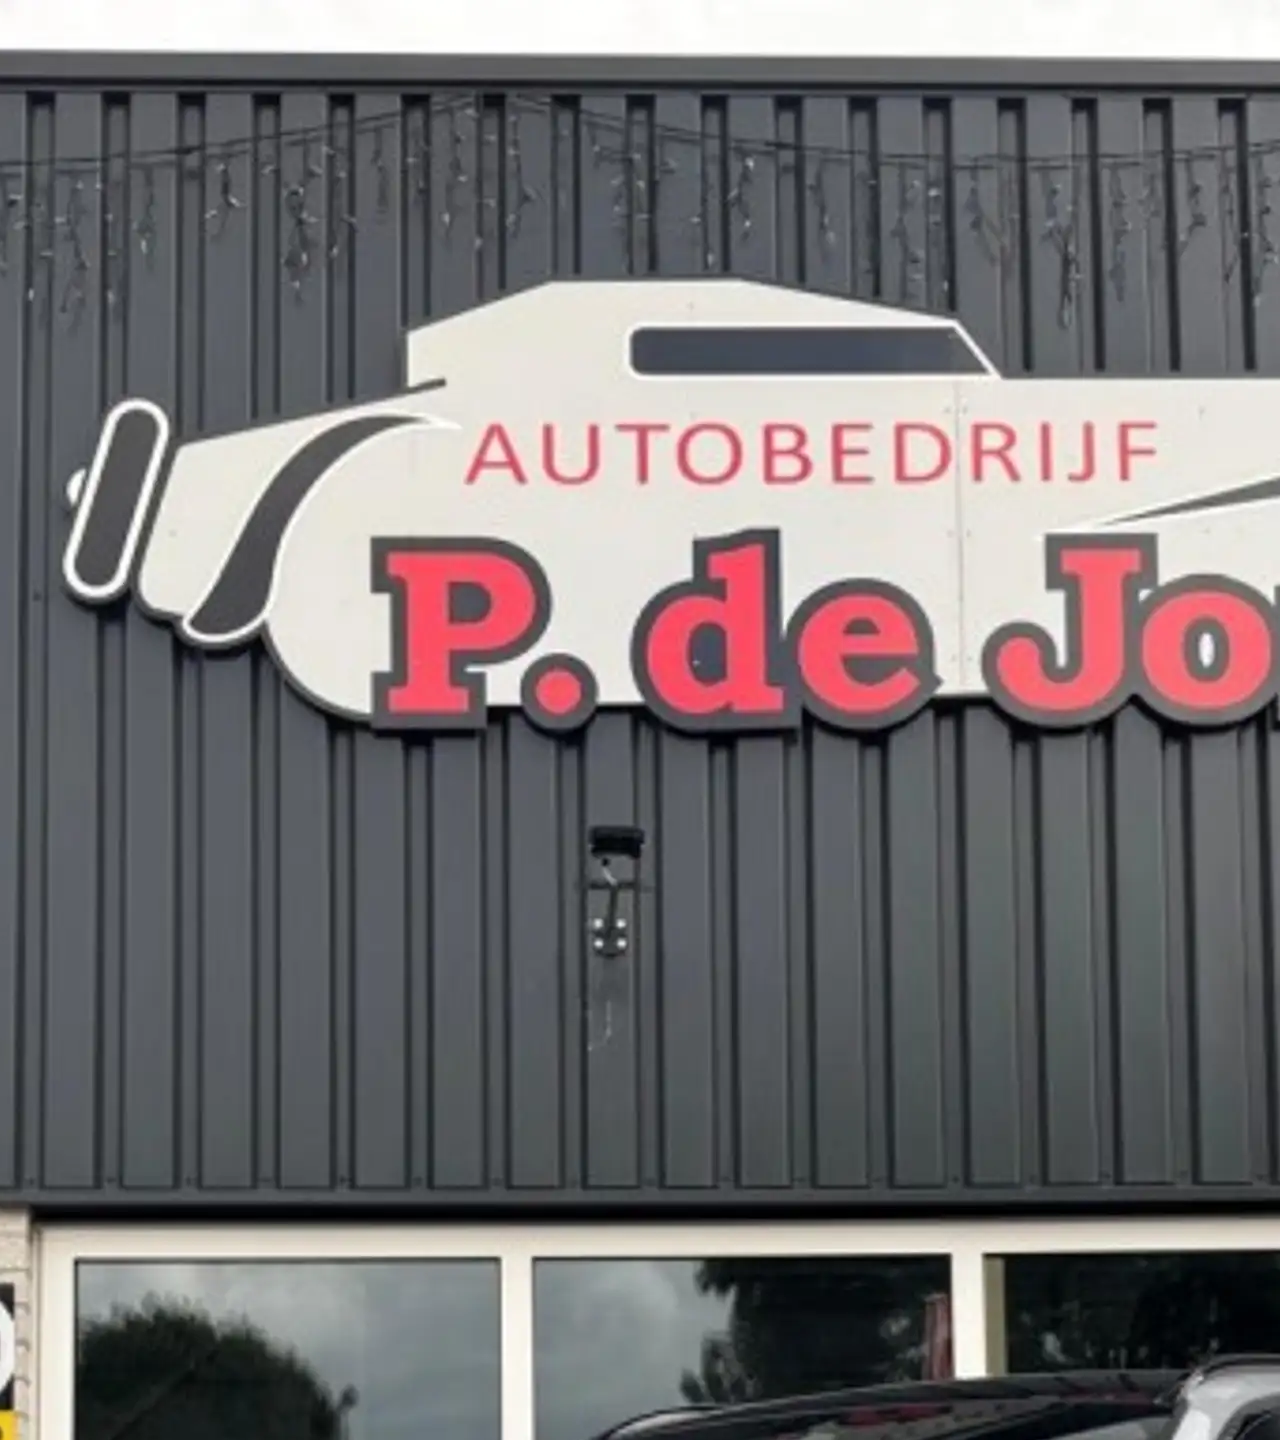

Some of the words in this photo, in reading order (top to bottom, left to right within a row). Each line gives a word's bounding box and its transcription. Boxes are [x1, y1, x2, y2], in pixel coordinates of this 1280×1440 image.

[463, 421, 1158, 486] AUTOBEDRIJF
[373, 539, 596, 728] P.
[633, 530, 934, 730] de
